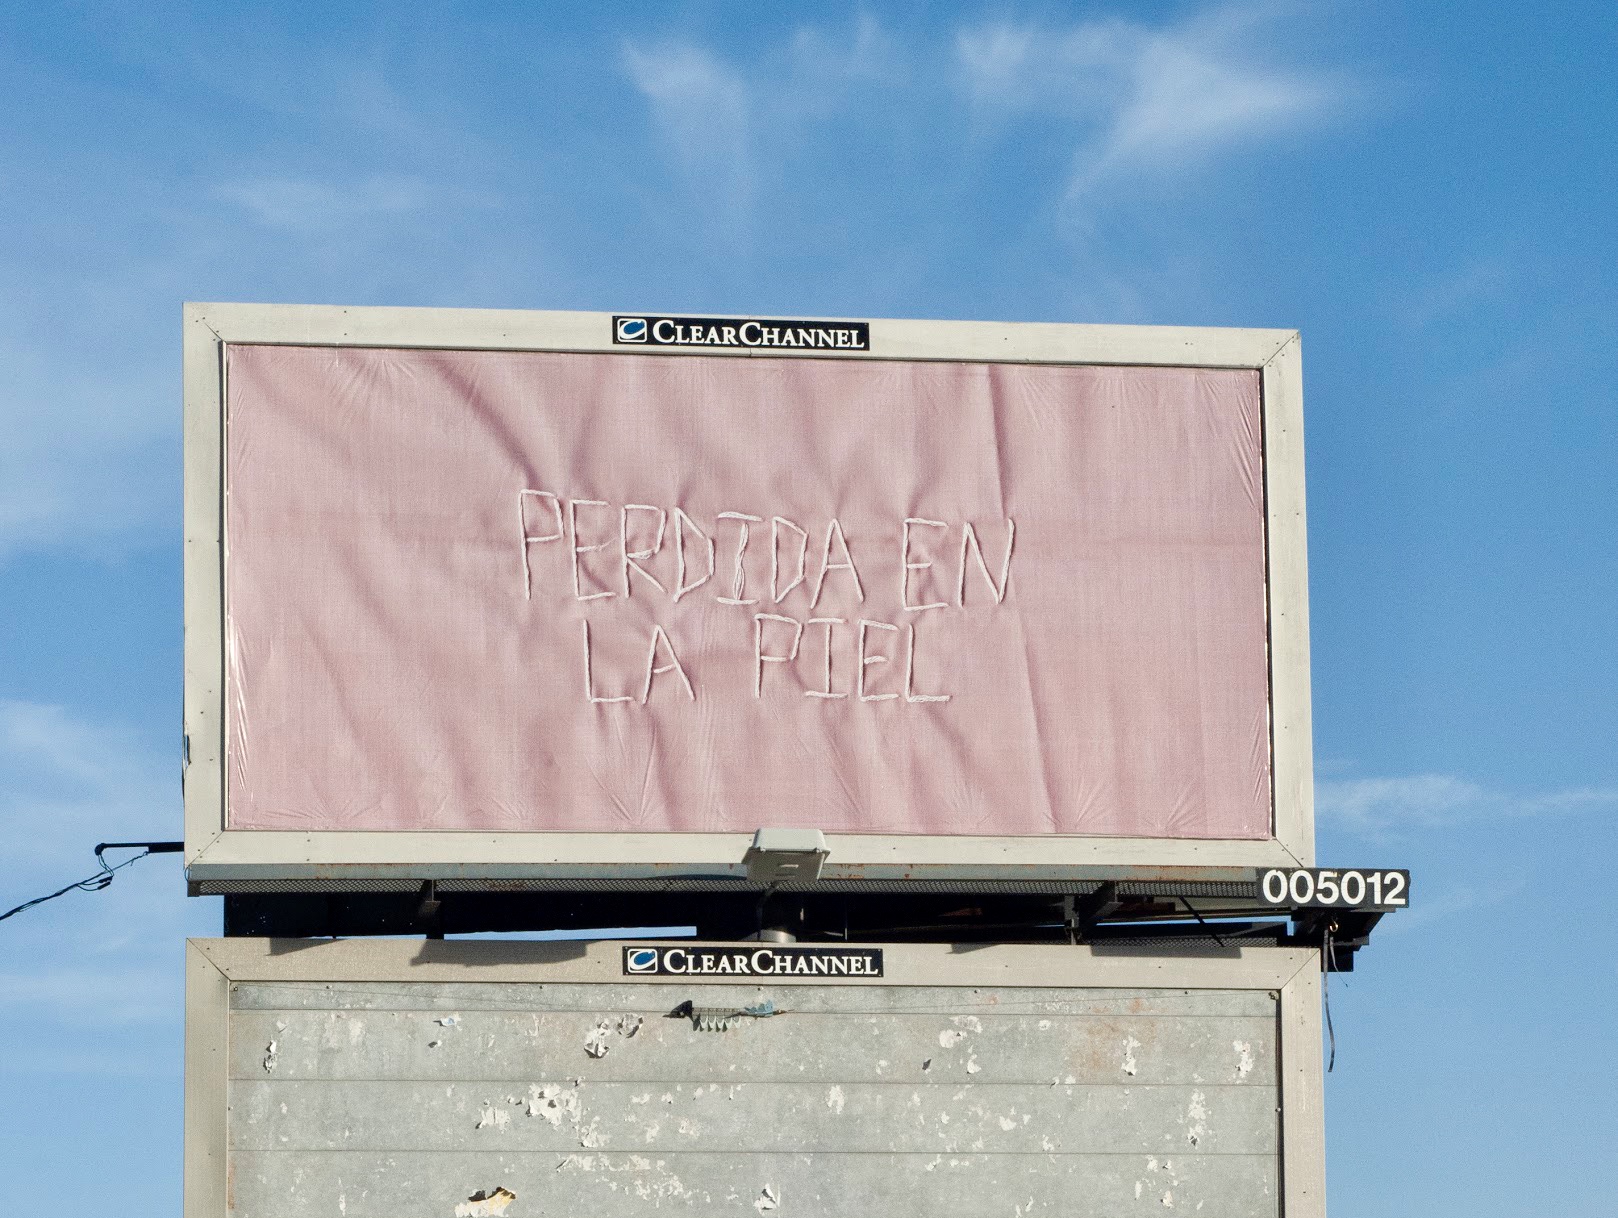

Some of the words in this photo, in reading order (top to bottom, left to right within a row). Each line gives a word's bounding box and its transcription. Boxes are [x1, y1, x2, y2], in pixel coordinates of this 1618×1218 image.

[652, 319, 865, 348] CLEARCHANNEL
[518, 488, 865, 609] PERDIDA
[901, 517, 1016, 611] EN
[583, 618, 696, 704] LA
[754, 613, 953, 702] PIEL
[1262, 869, 1406, 905] 005012
[663, 949, 879, 975] CLEARCHANNEL
